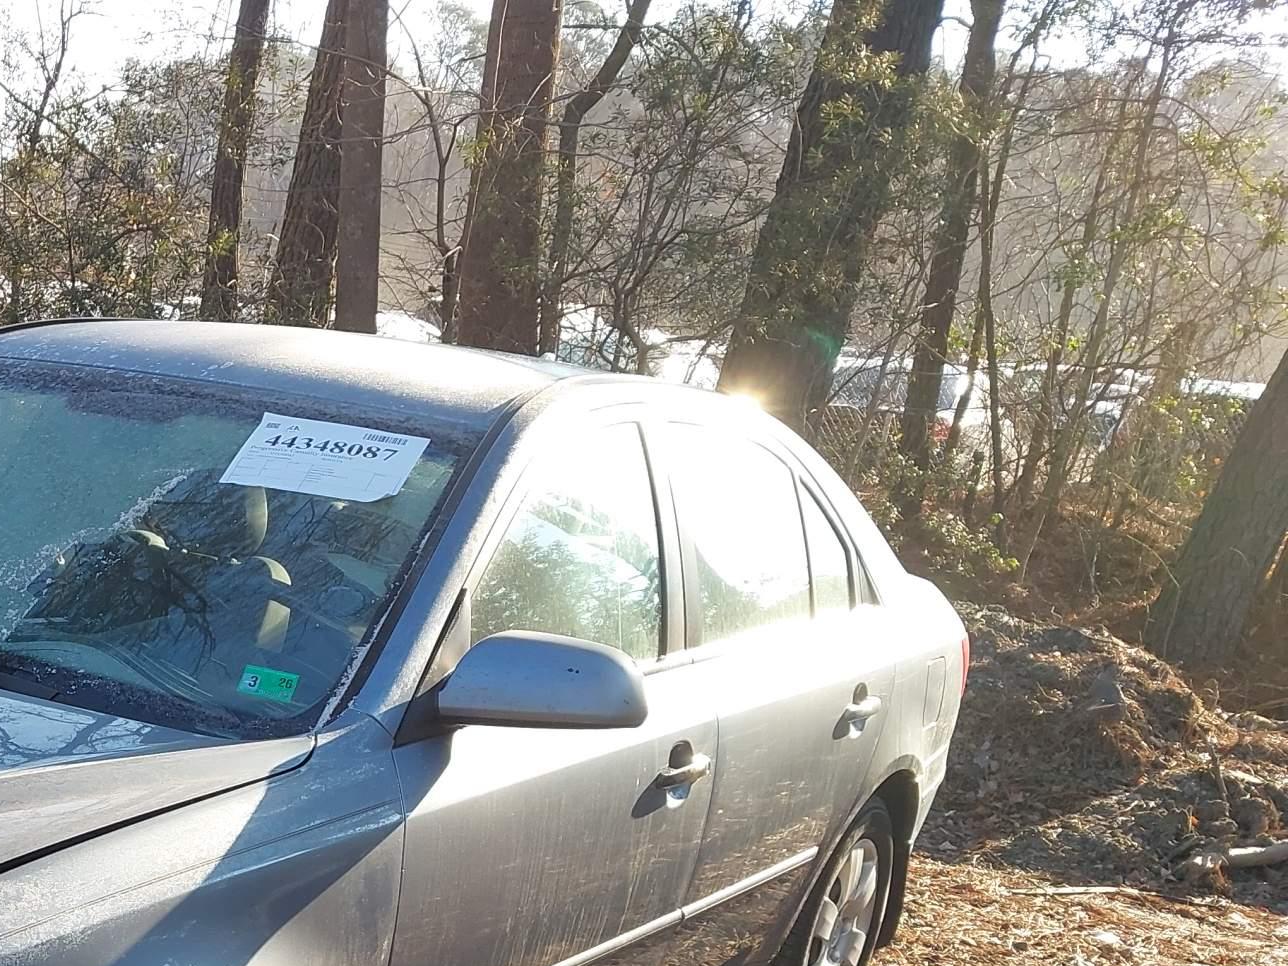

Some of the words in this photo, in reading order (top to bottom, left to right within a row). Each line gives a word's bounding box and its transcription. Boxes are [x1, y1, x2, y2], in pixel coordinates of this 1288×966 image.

[265, 434, 399, 461] 44348087
[248, 676, 258, 687] 3
[279, 677, 293, 689] 26
